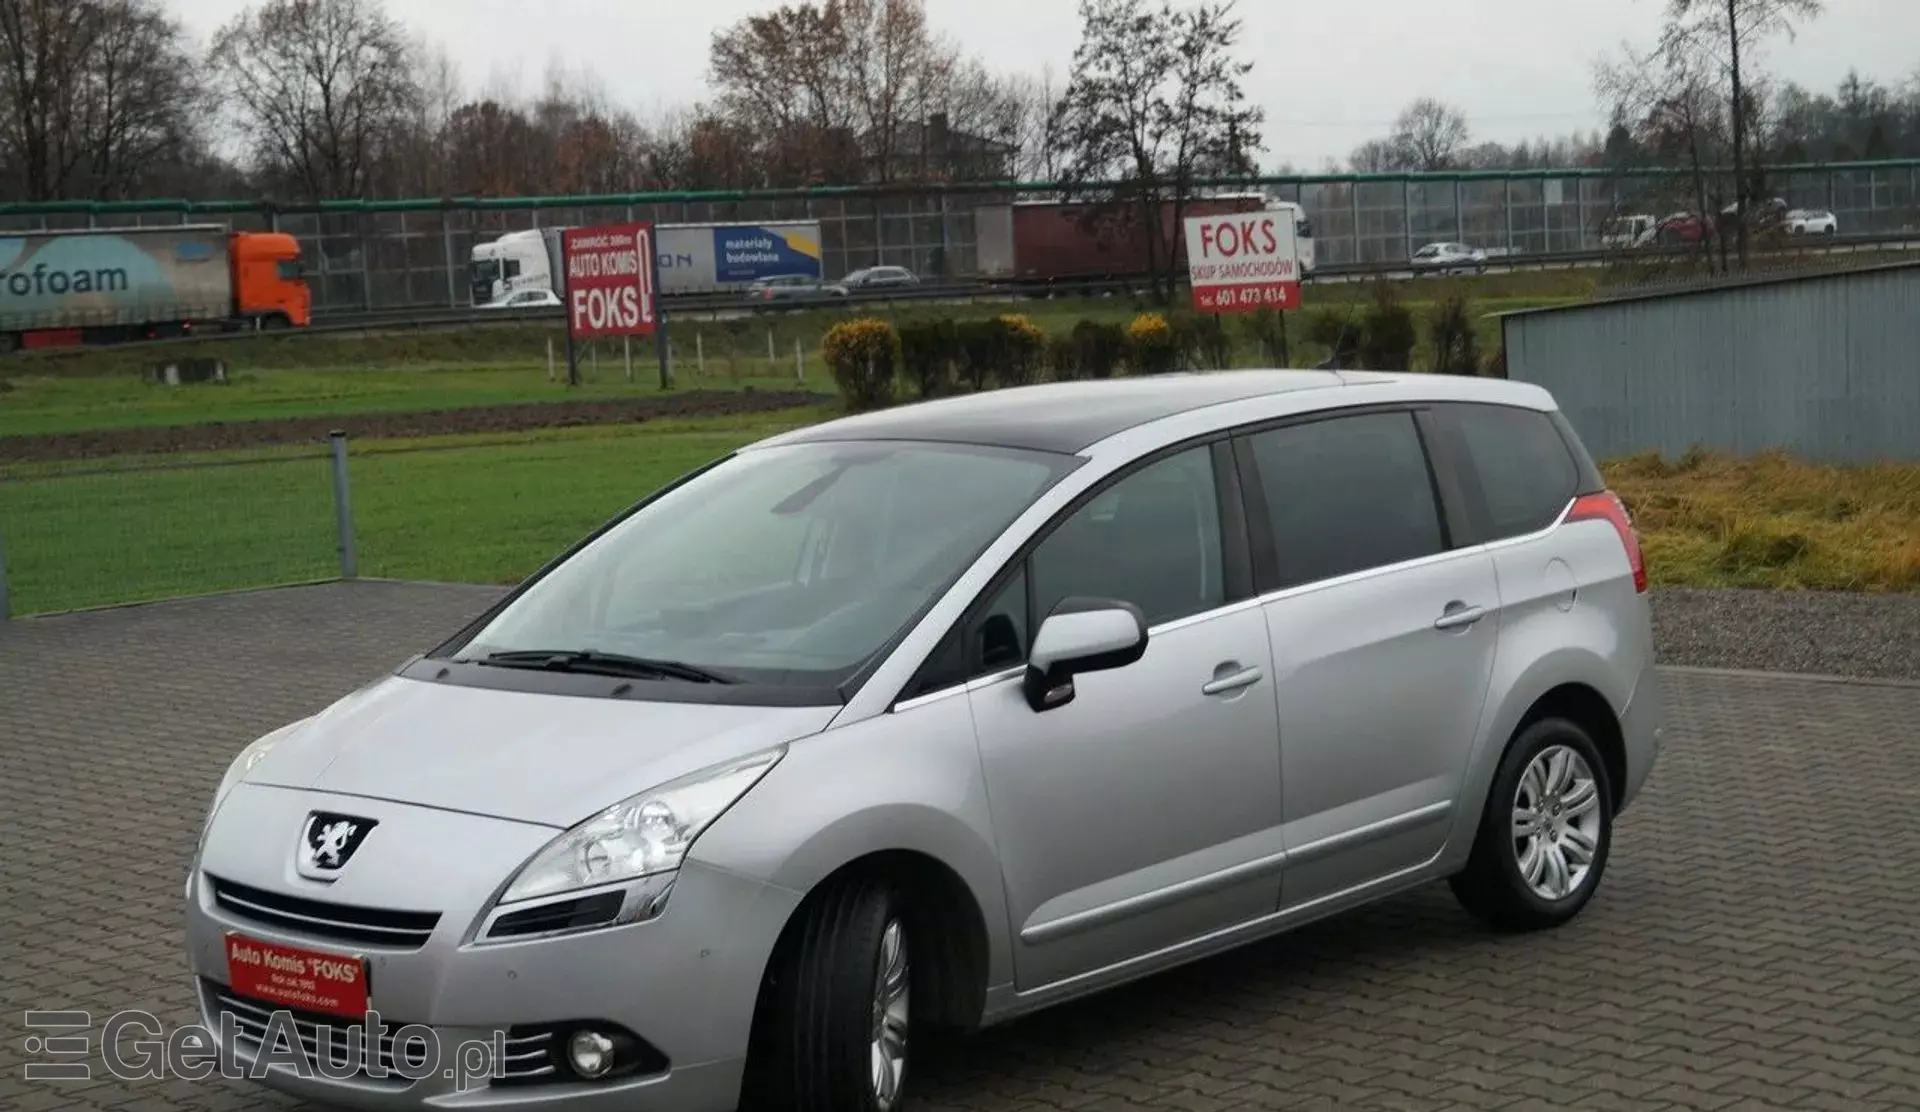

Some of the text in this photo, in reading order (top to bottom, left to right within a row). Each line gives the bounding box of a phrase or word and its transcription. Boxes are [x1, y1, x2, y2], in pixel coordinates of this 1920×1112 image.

[1200, 219, 1277, 258] FOKS
[569, 249, 638, 277] AUTO KOMIS
[1192, 257, 1294, 281] SKUP SAMOCHODÓW
[572, 285, 639, 329] FOKS
[1216, 288, 1236, 306] 601
[1239, 287, 1261, 304] 473
[1264, 286, 1286, 303] 414
[231, 943, 360, 984] Auto Komis "FOKS"
